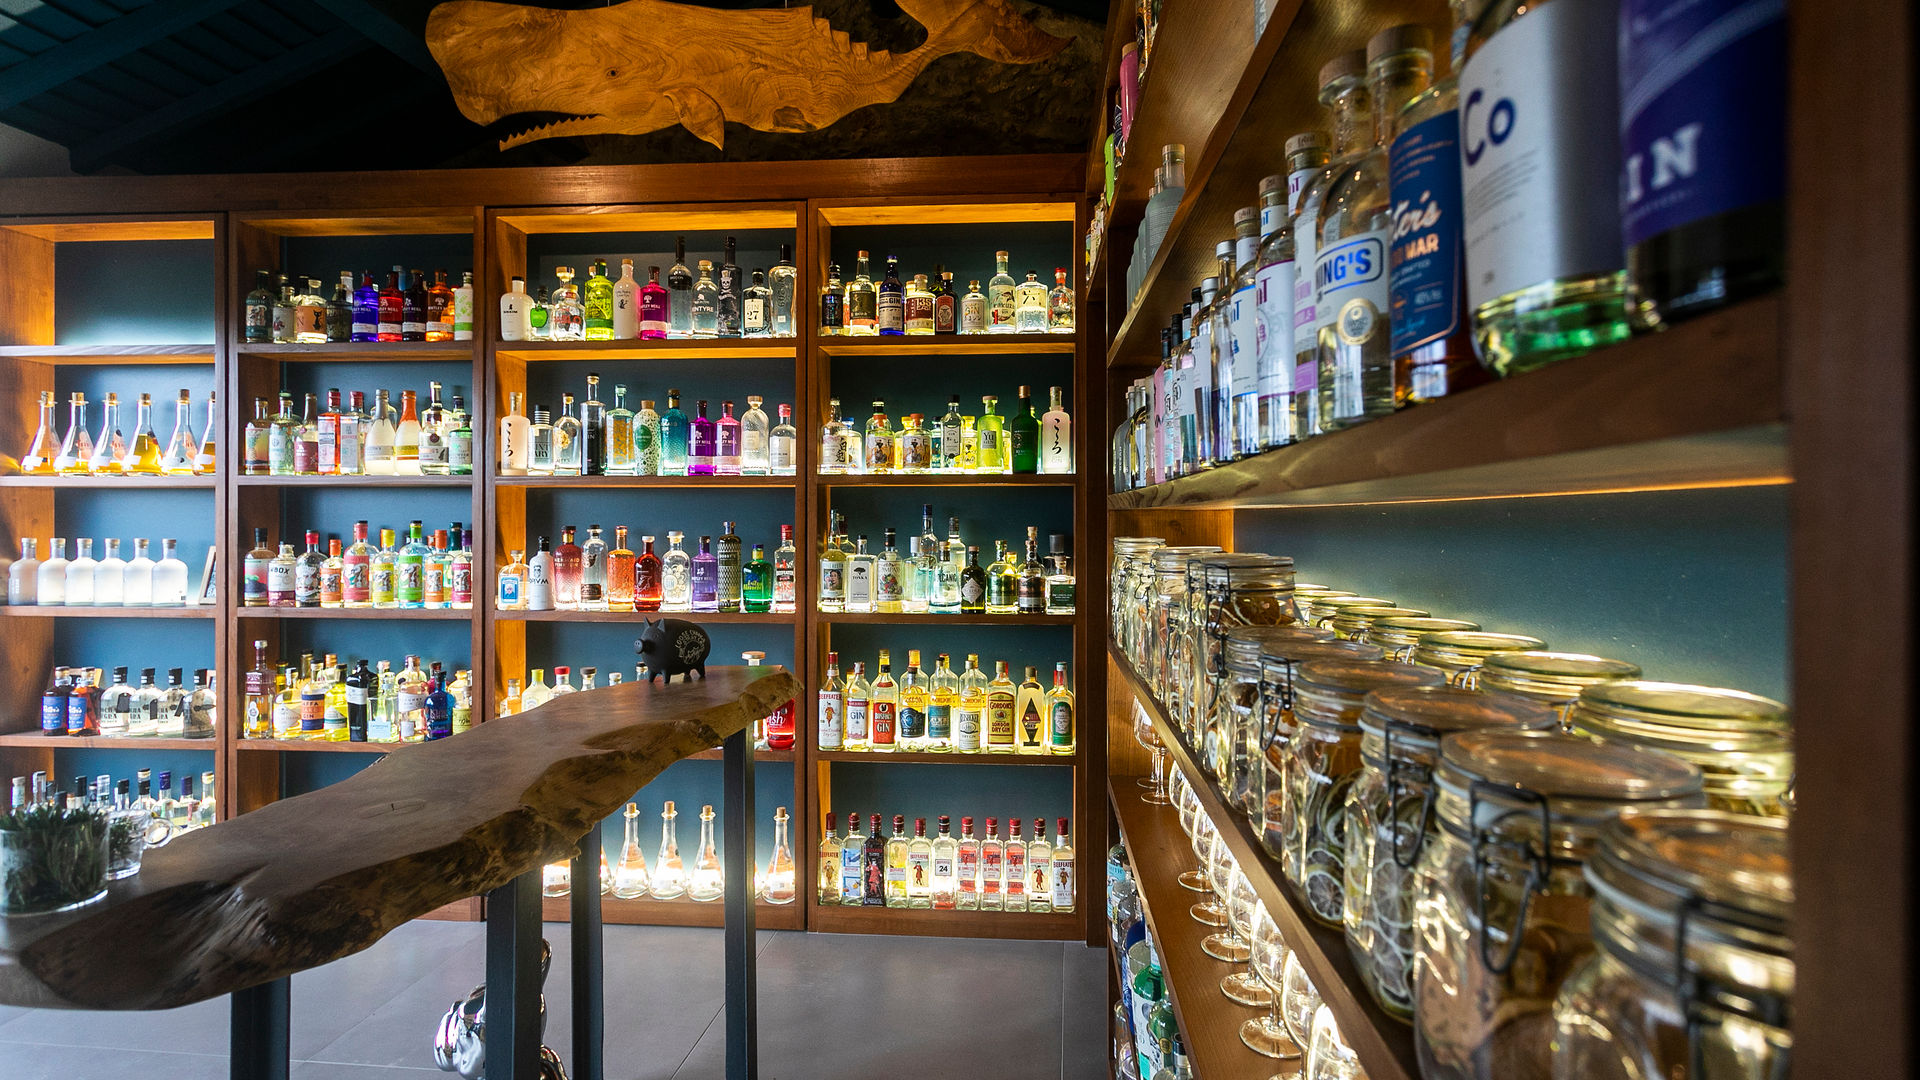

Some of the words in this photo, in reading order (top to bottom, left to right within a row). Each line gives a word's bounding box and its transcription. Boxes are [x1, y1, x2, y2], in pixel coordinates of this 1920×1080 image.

[1462, 87, 1517, 168] Co
[1626, 121, 1704, 204] IN
[746, 310, 759, 320] 27
[983, 433, 994, 441] Yu
[850, 711, 865, 720] GIN
[876, 722, 890, 733] GIN
[939, 865, 949, 873] 24
